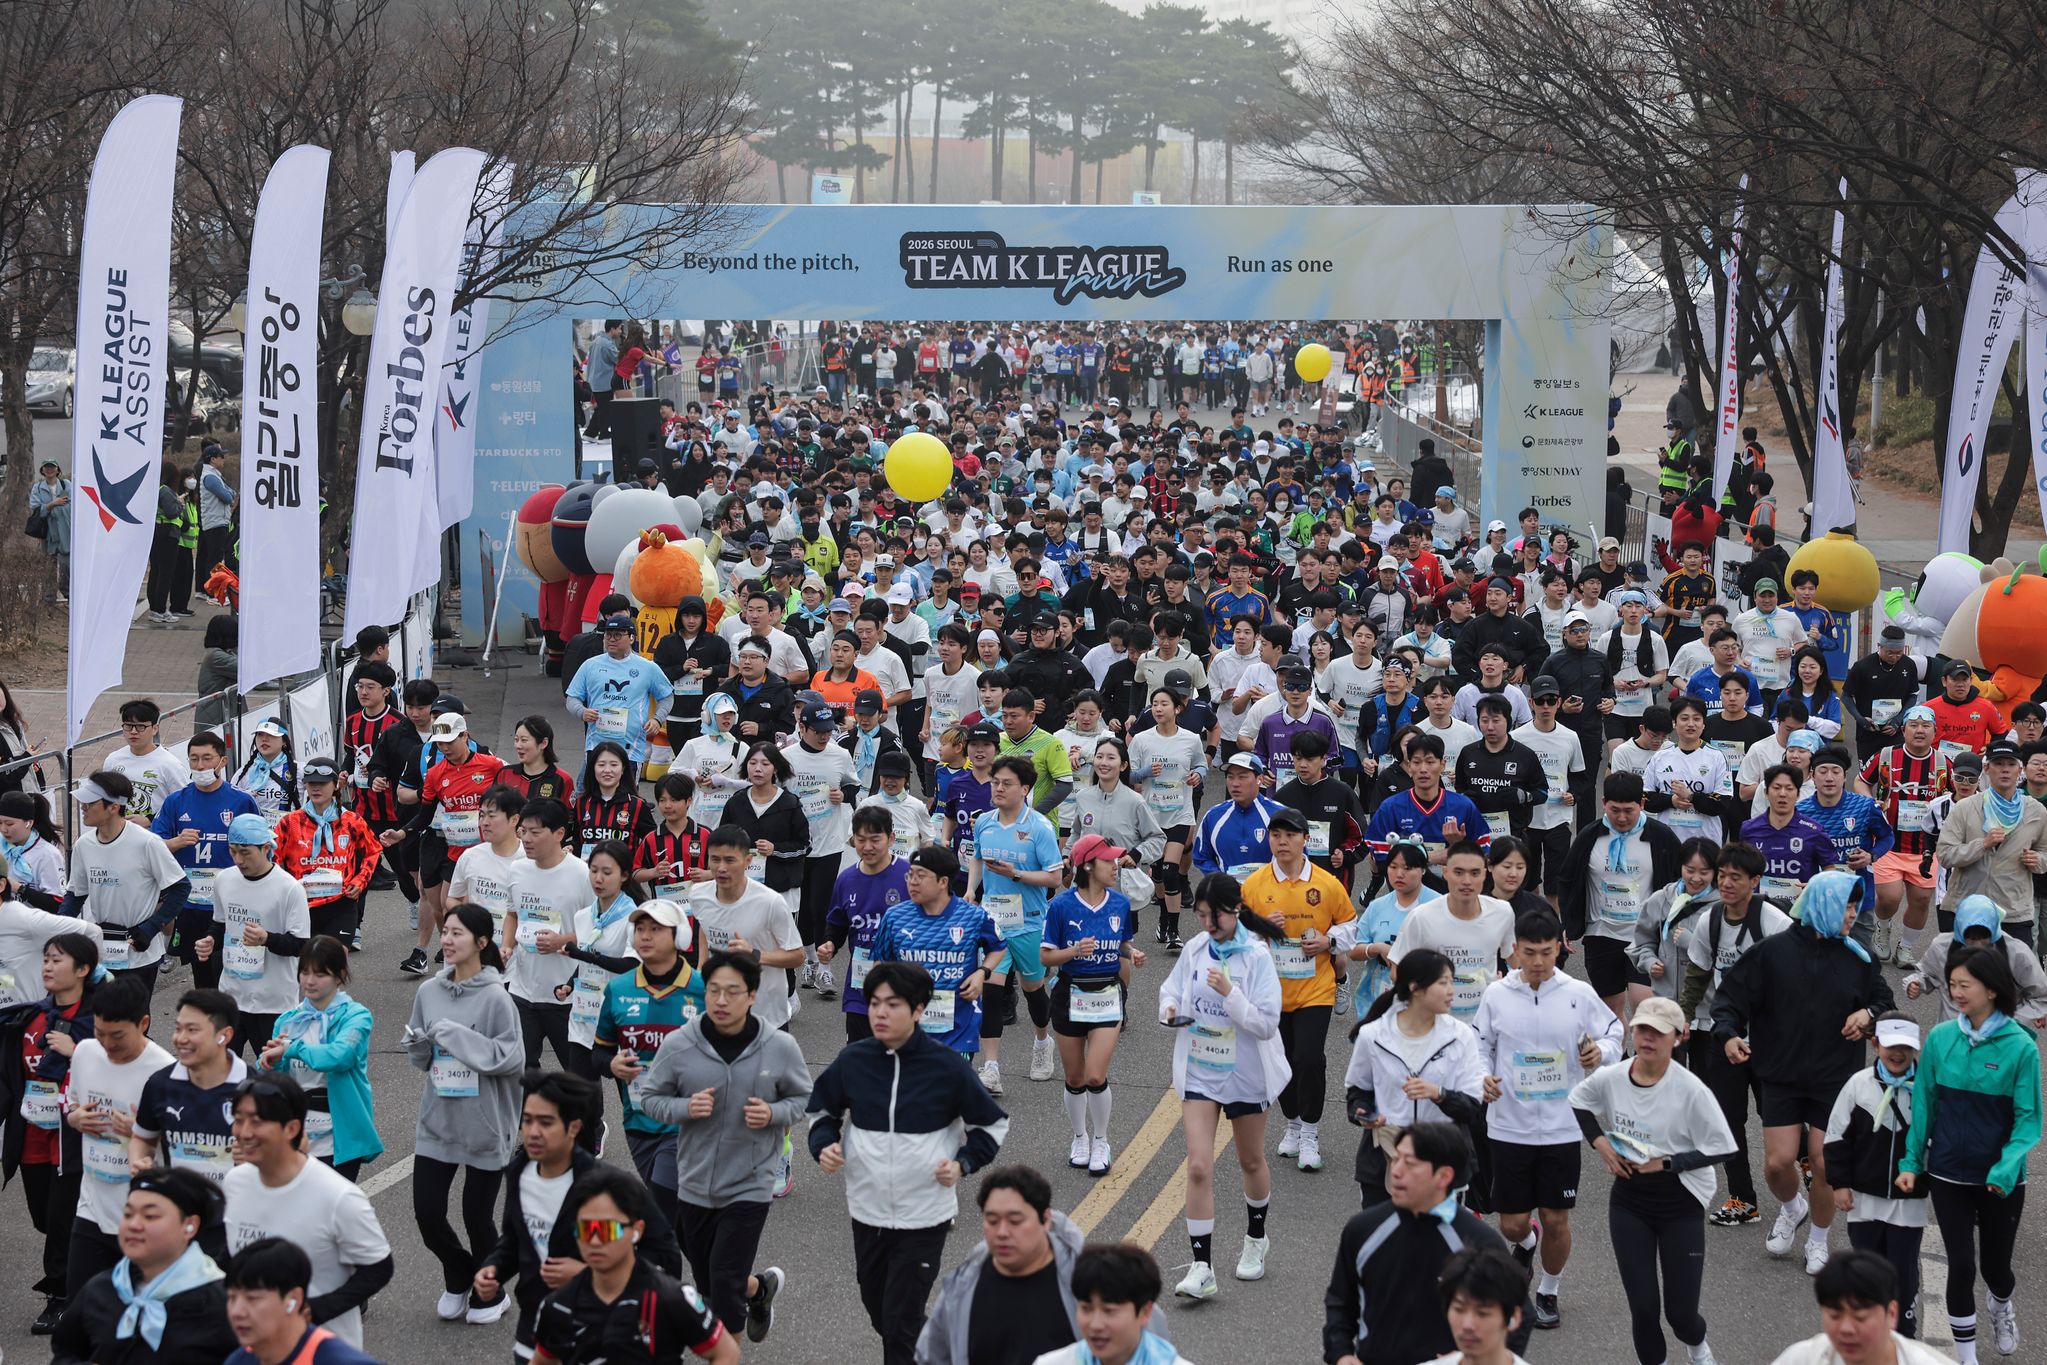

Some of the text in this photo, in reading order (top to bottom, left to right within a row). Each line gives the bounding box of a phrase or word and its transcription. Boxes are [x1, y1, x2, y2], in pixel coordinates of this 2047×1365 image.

[908, 239, 974, 250] 2026 SEOUL
[683, 252, 860, 274] Beyond the pitch,
[907, 253, 1161, 280] TEAM K LEAGUE
[1227, 256, 1333, 272] Run as one
[1061, 271, 1178, 298] run
[100, 267, 128, 441] K LEAGUE
[124, 309, 151, 446] ASSIST
[375, 285, 436, 479] Forbes
[502, 380, 542, 393] 동원샘물
[1533, 379, 1572, 389] 중앙일보
[255, 286, 301, 510] 월간중앙
[1539, 408, 1584, 416] K LEAGUE
[380, 404, 391, 433] Korea
[512, 411, 537, 426] 링티
[1537, 438, 1584, 446] 문화체육관광부
[543, 448, 562, 457] RTD
[490, 480, 543, 492] 7-ELEVE
[1530, 495, 1572, 507] Forbes
[639, 622, 660, 654] 12
[1272, 752, 1294, 761] ANY
[1470, 777, 1511, 788] SEONGNAM
[1664, 780, 1705, 793] NXO
[1481, 785, 1498, 793] CITY
[452, 792, 482, 807] high
[582, 828, 594, 840] GS
[195, 842, 212, 864] 14
[300, 854, 347, 866] CHEONAN
[477, 879, 497, 889] TEAM
[482, 888, 508, 899] LEAGU
[520, 896, 540, 904] TEAM
[228, 906, 248, 916] TEAM
[237, 956, 258, 965] 21005
[899, 950, 966, 964] SAMSUNG
[943, 966, 964, 979] S25
[1091, 1000, 1115, 1008] 54009
[1205, 1046, 1230, 1056] 44047
[448, 1070, 471, 1079] 34017
[1615, 1116, 1635, 1128] EAM
[166, 1130, 237, 1146] SAMSUNG
[1563, 1189, 1577, 1198] KM
